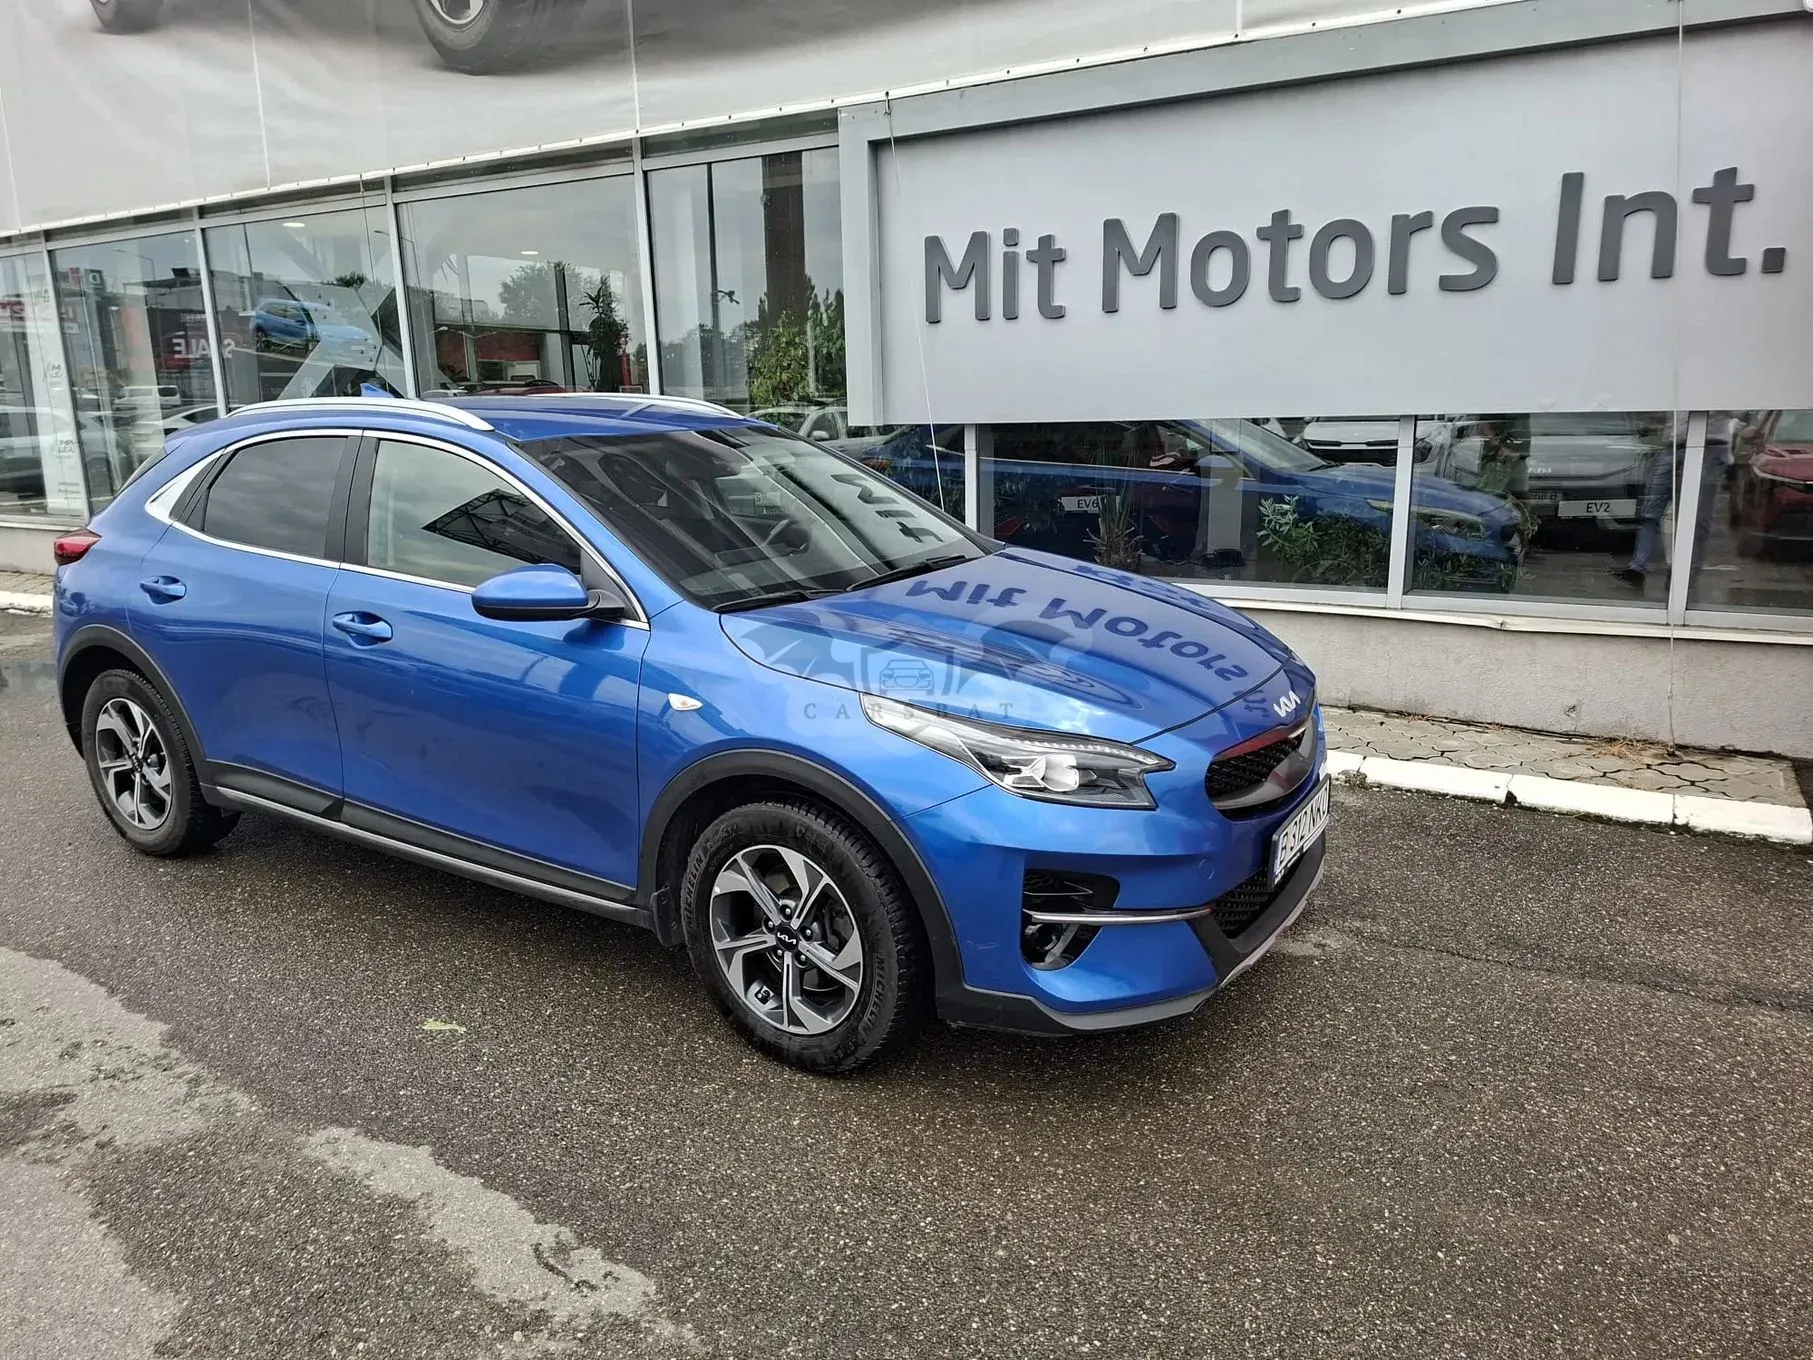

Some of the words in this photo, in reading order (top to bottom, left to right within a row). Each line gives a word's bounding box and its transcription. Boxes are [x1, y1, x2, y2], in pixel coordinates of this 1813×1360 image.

[923, 226, 1066, 324] Mit
[1102, 204, 1501, 313] Motors
[1551, 165, 1786, 285] Int.
[1586, 502, 1611, 513] EV2
